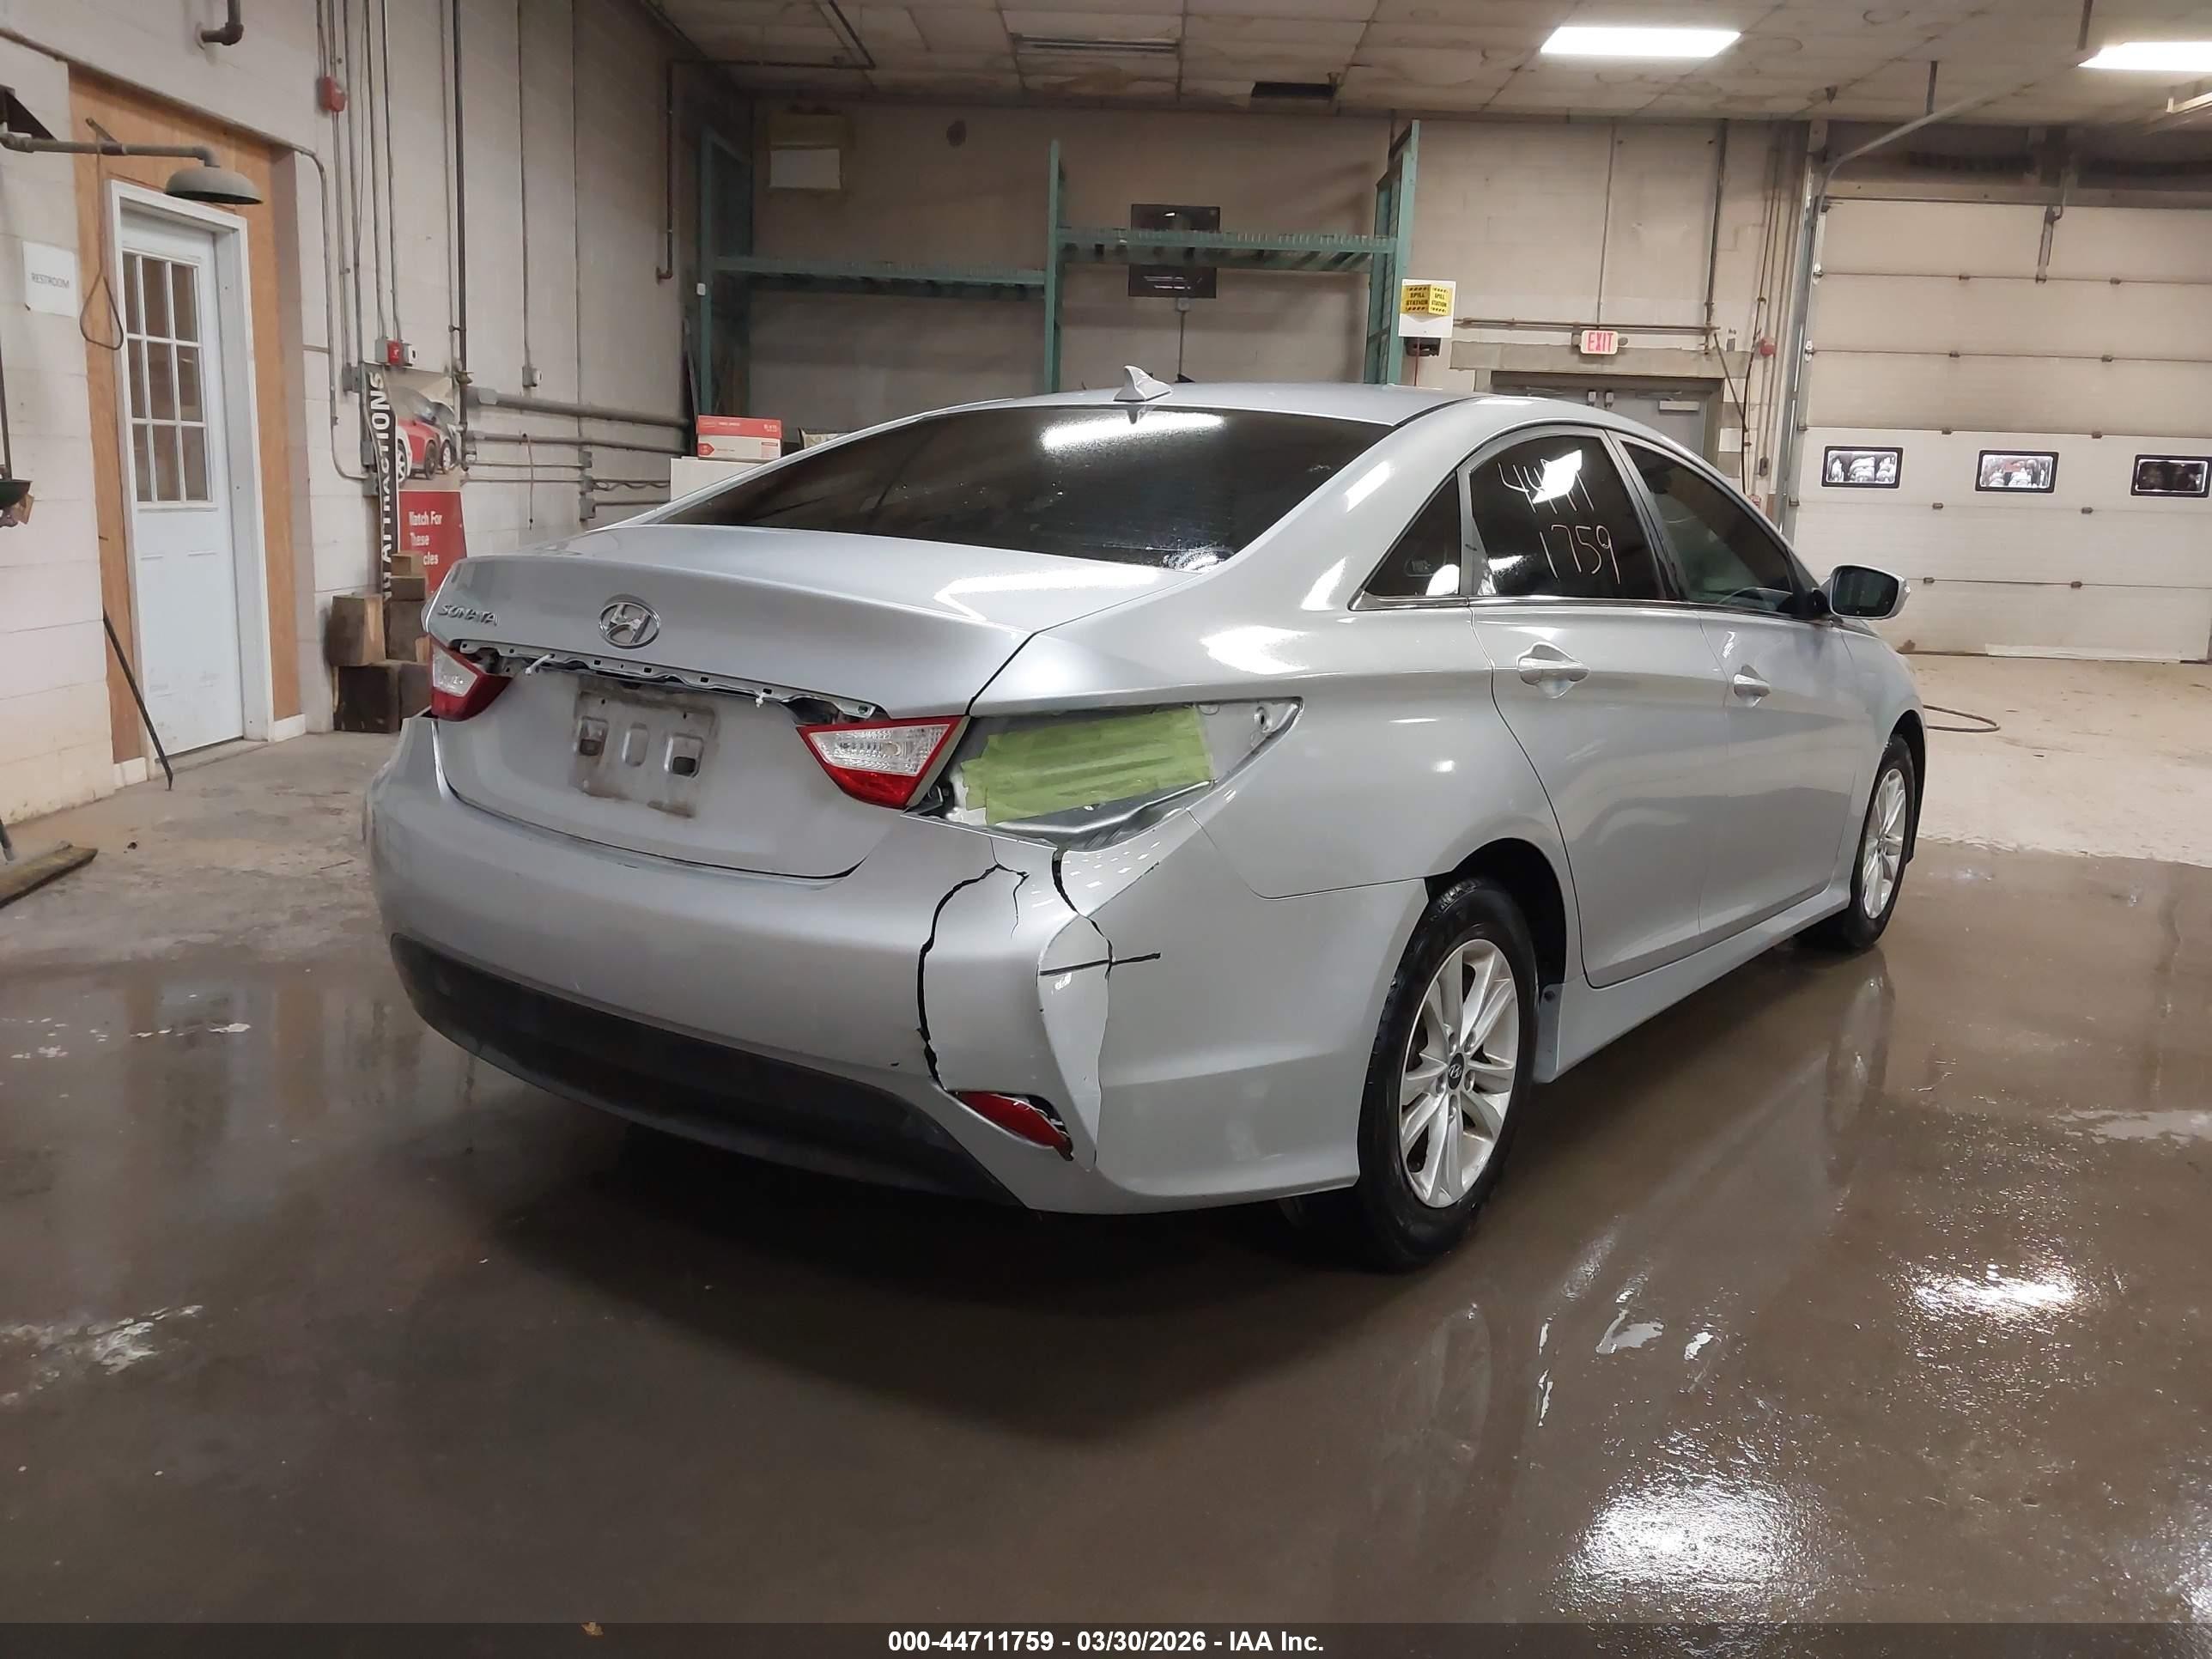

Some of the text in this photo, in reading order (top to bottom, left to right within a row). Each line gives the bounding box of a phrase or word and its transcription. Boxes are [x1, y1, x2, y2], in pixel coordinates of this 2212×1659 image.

[31, 272, 70, 289] RESTROOM
[1588, 331, 1614, 352] EXIT
[430, 511, 443, 526] For
[1540, 524, 1620, 585] 1759
[438, 605, 499, 627] SONATA
